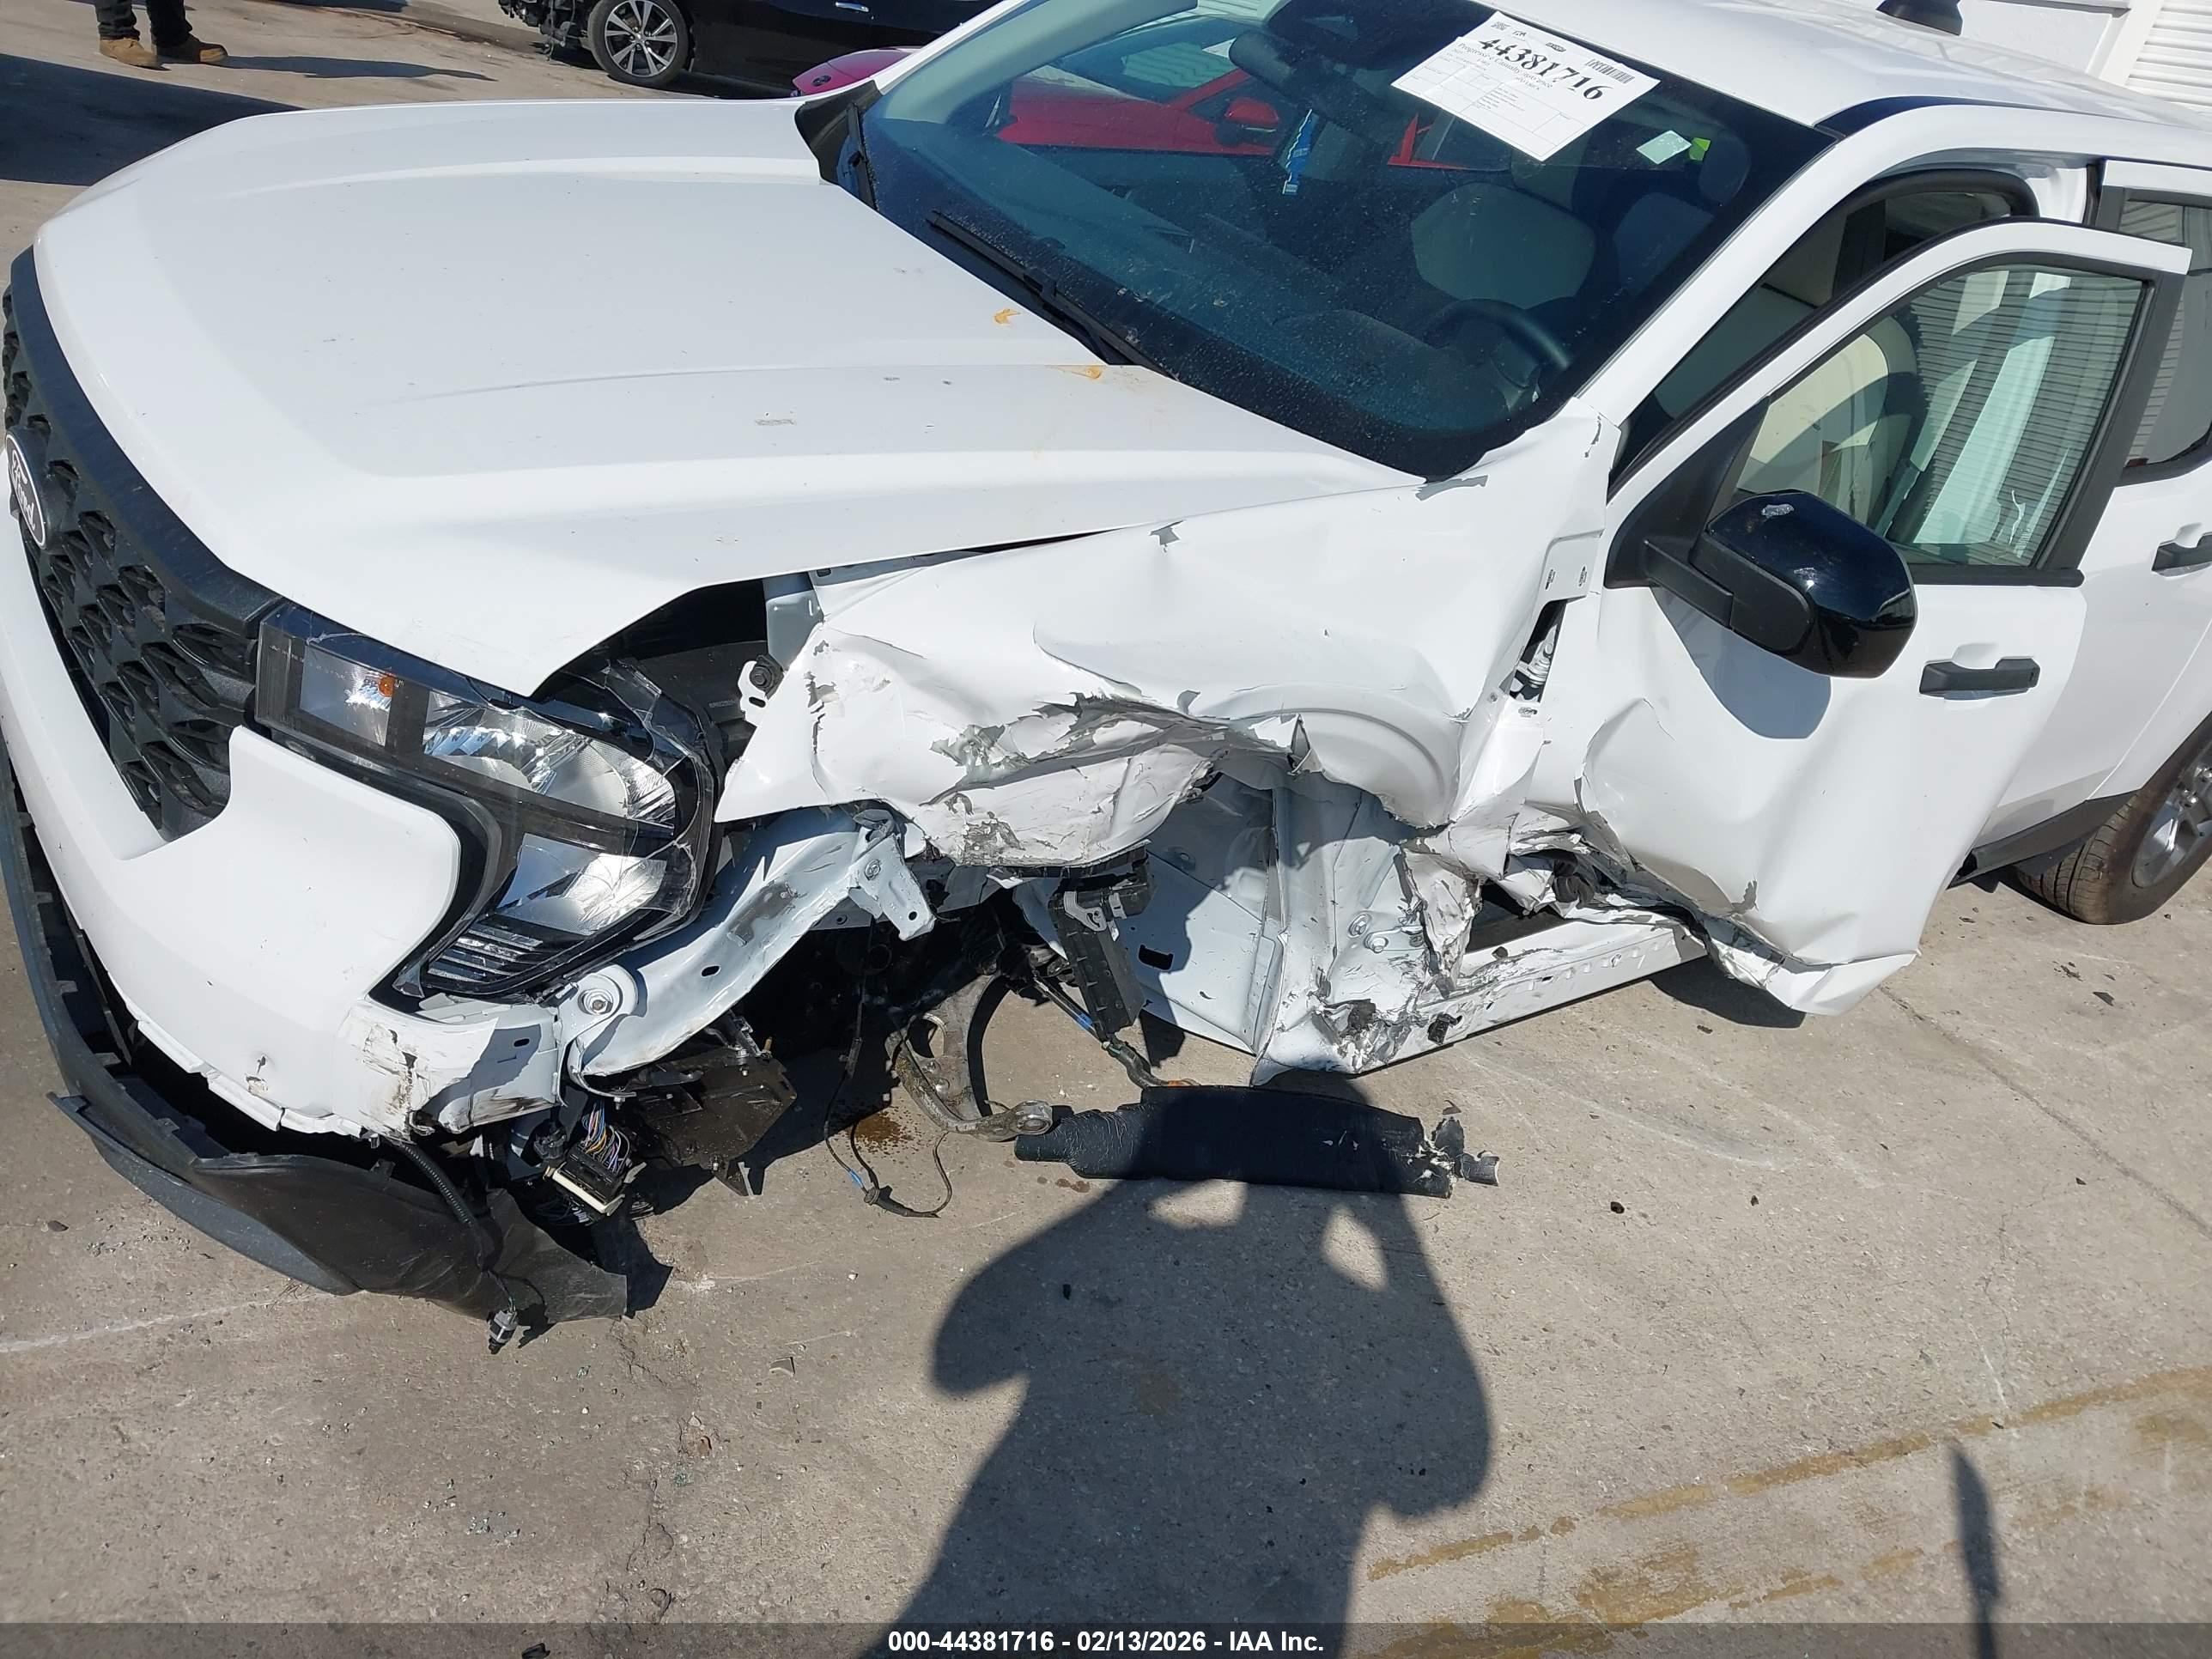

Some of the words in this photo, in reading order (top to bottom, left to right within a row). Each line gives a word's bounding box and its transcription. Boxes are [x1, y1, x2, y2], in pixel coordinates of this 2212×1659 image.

[1479, 39, 1613, 100] 44381716
[1522, 71, 1553, 88] nsurance
[11, 448, 36, 532] Ford
